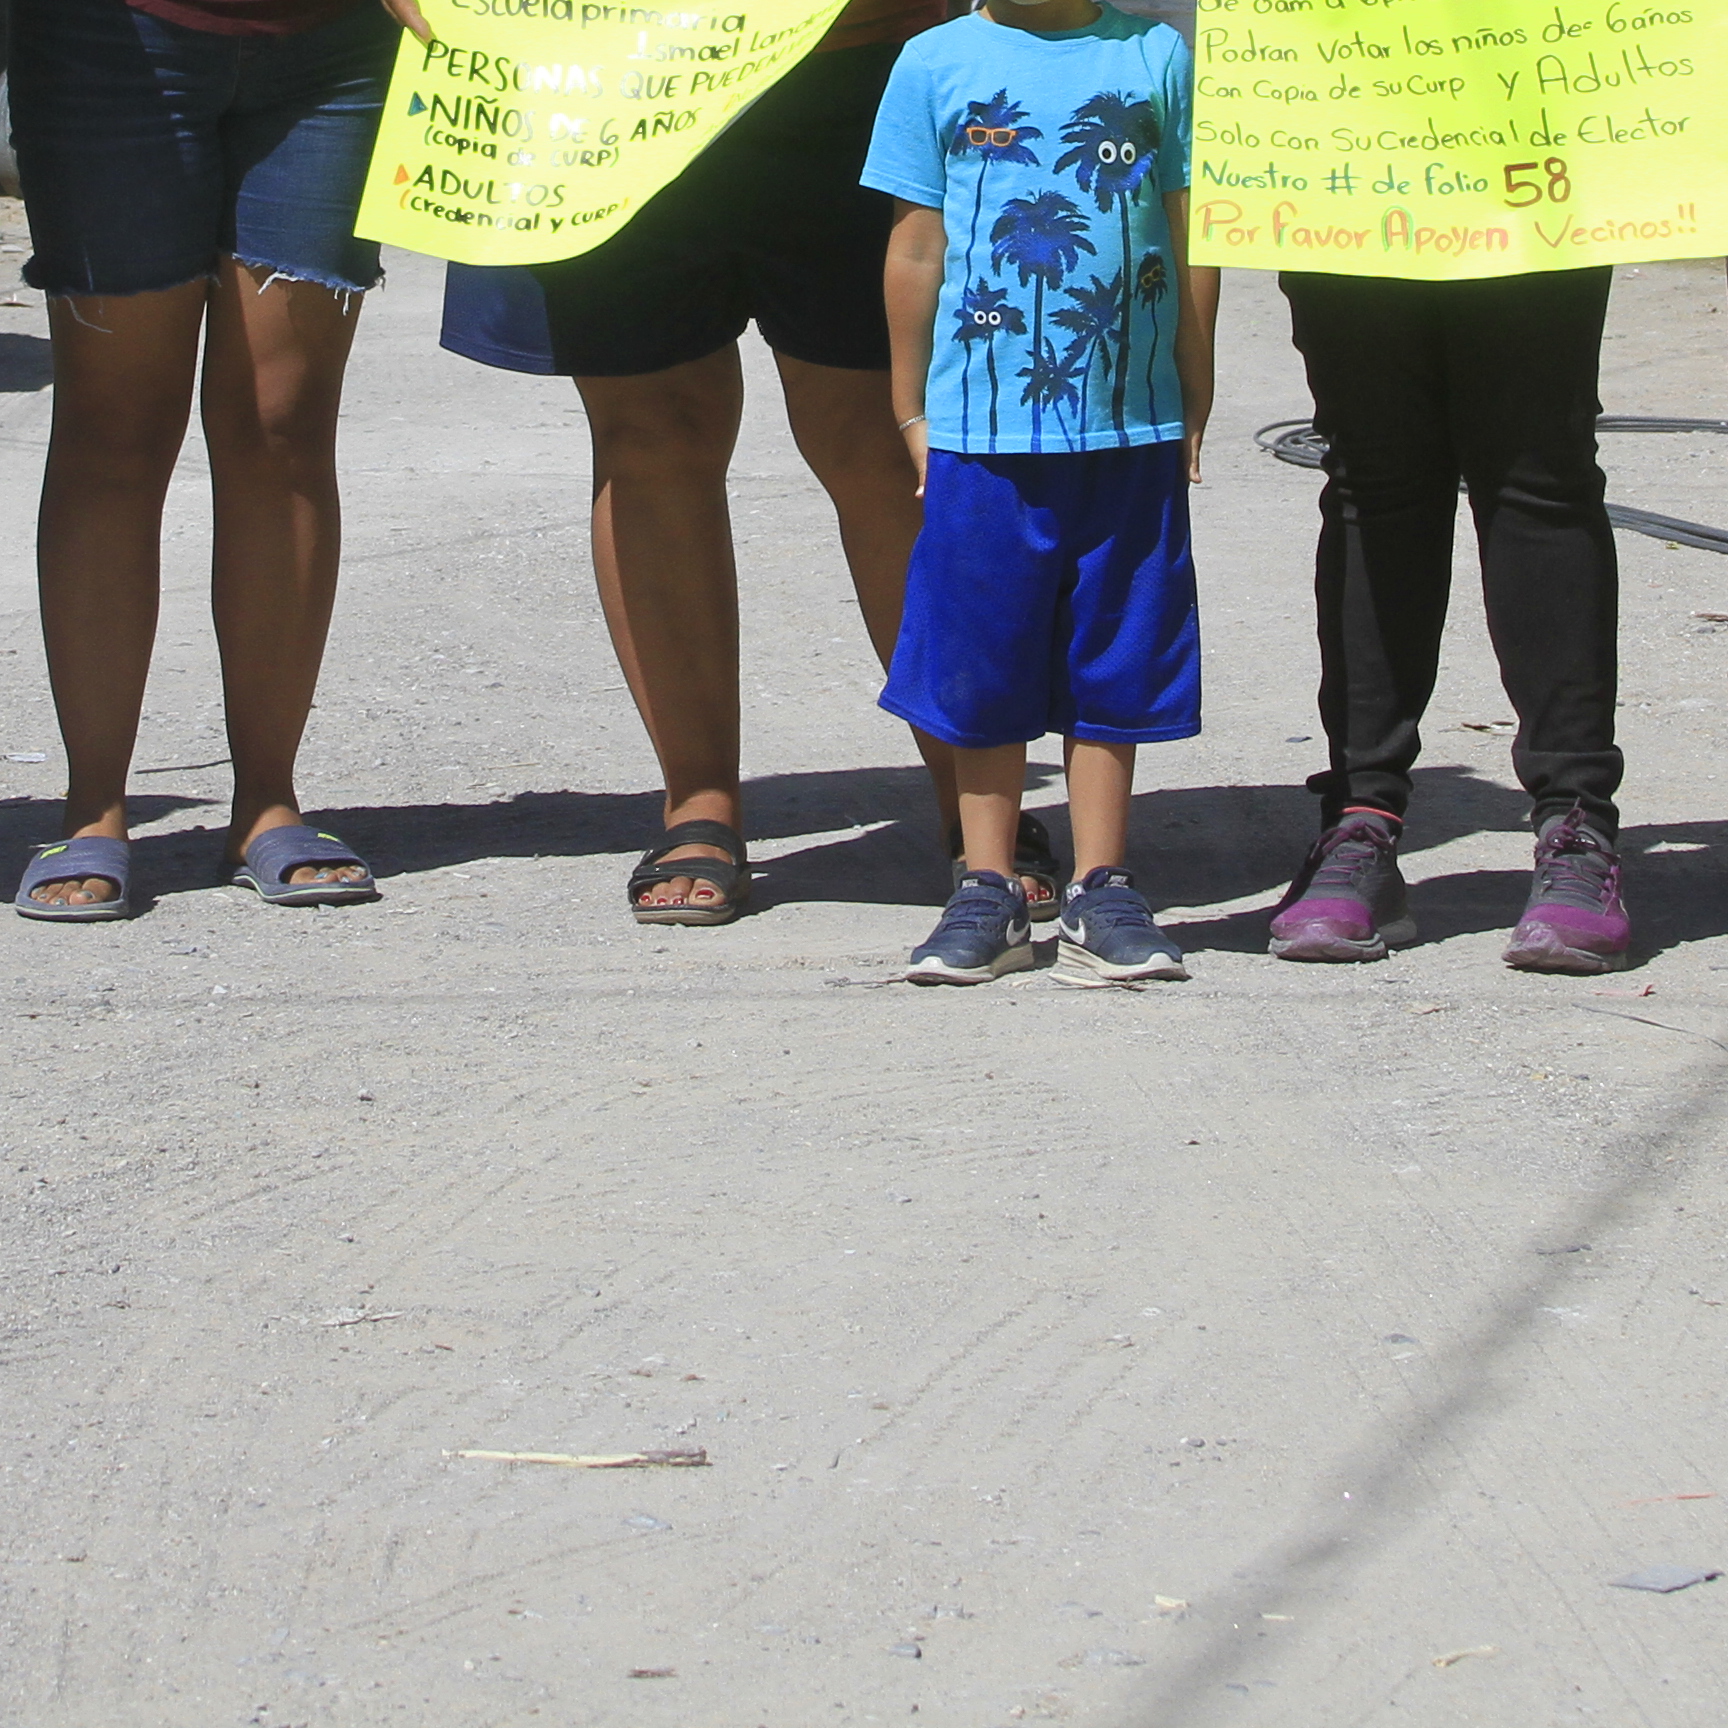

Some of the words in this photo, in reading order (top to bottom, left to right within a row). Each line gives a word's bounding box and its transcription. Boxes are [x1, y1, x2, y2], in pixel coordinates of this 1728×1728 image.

[580, 1, 747, 34] primaria
[1198, 26, 1300, 64] Podran
[1401, 23, 1445, 57] los
[421, 38, 606, 100] PERSONAS
[618, 69, 683, 102] QUE
[1327, 72, 1363, 101] de
[1535, 43, 1696, 96] Adultos
[428, 92, 538, 143] NIÑOS
[1194, 120, 1261, 149] Solo
[1529, 106, 1569, 148] de
[1577, 106, 1692, 144] Elector
[412, 162, 568, 209] ADULTOS
[1201, 158, 1309, 192] Nuestro
[1319, 160, 1364, 197] #
[1371, 162, 1412, 196] de
[1423, 161, 1490, 197] folio
[1502, 156, 1573, 209] 58
[1194, 198, 1263, 248] Por
[1380, 204, 1511, 258] Apoyen
[1533, 202, 1698, 250] Vecinos!!
